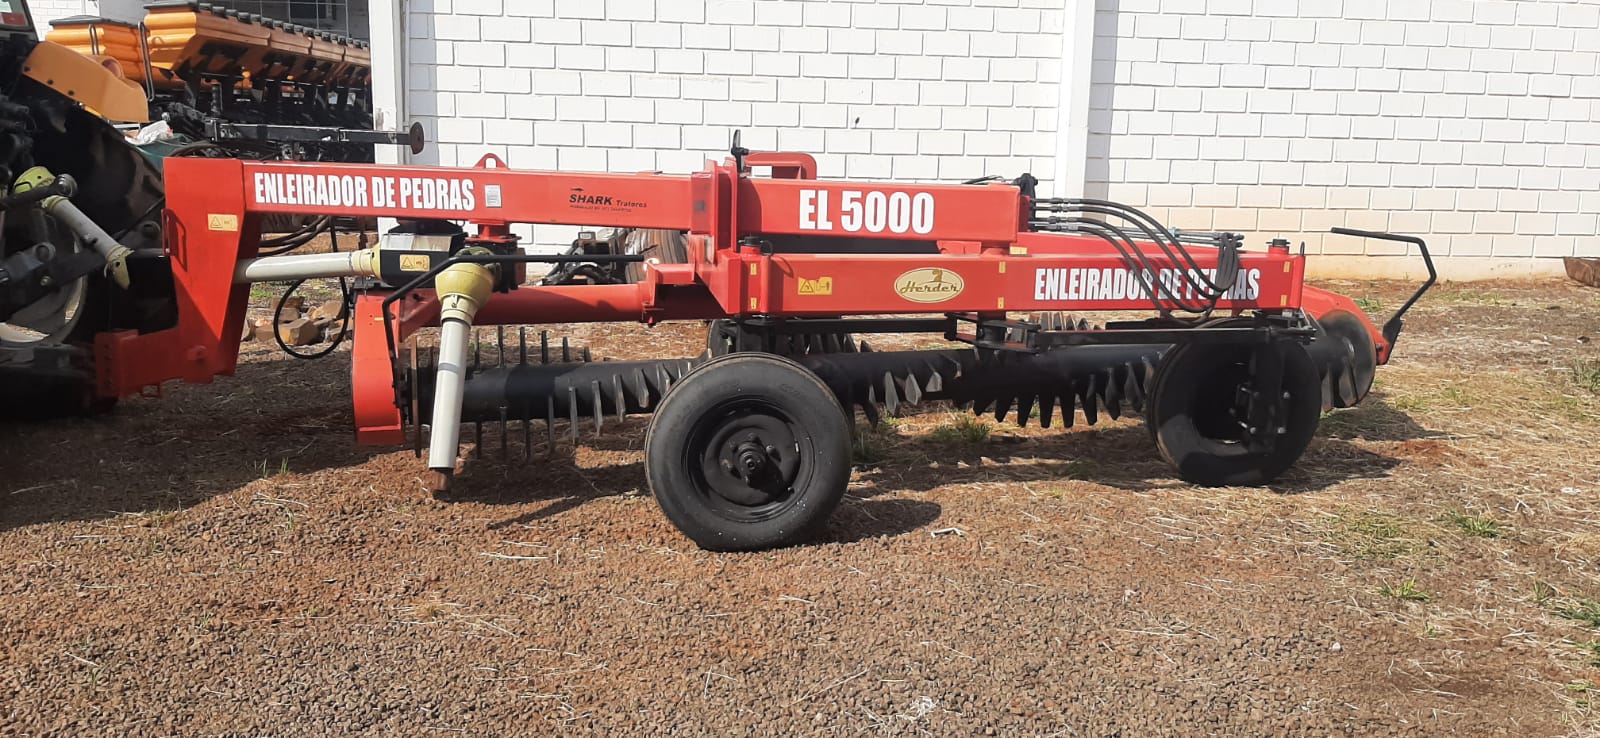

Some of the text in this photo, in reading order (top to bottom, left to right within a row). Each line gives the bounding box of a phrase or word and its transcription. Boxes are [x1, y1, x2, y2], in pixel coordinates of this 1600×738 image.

[254, 172, 368, 207] ENLEIRADOR
[371, 176, 396, 208] DE
[399, 177, 475, 211] PEDRAS
[569, 193, 613, 206] SHARK
[799, 189, 935, 234] EL 5000
[900, 280, 958, 294] Herder
[1034, 268, 1260, 300] ENLEIRADOR DE PEAS
